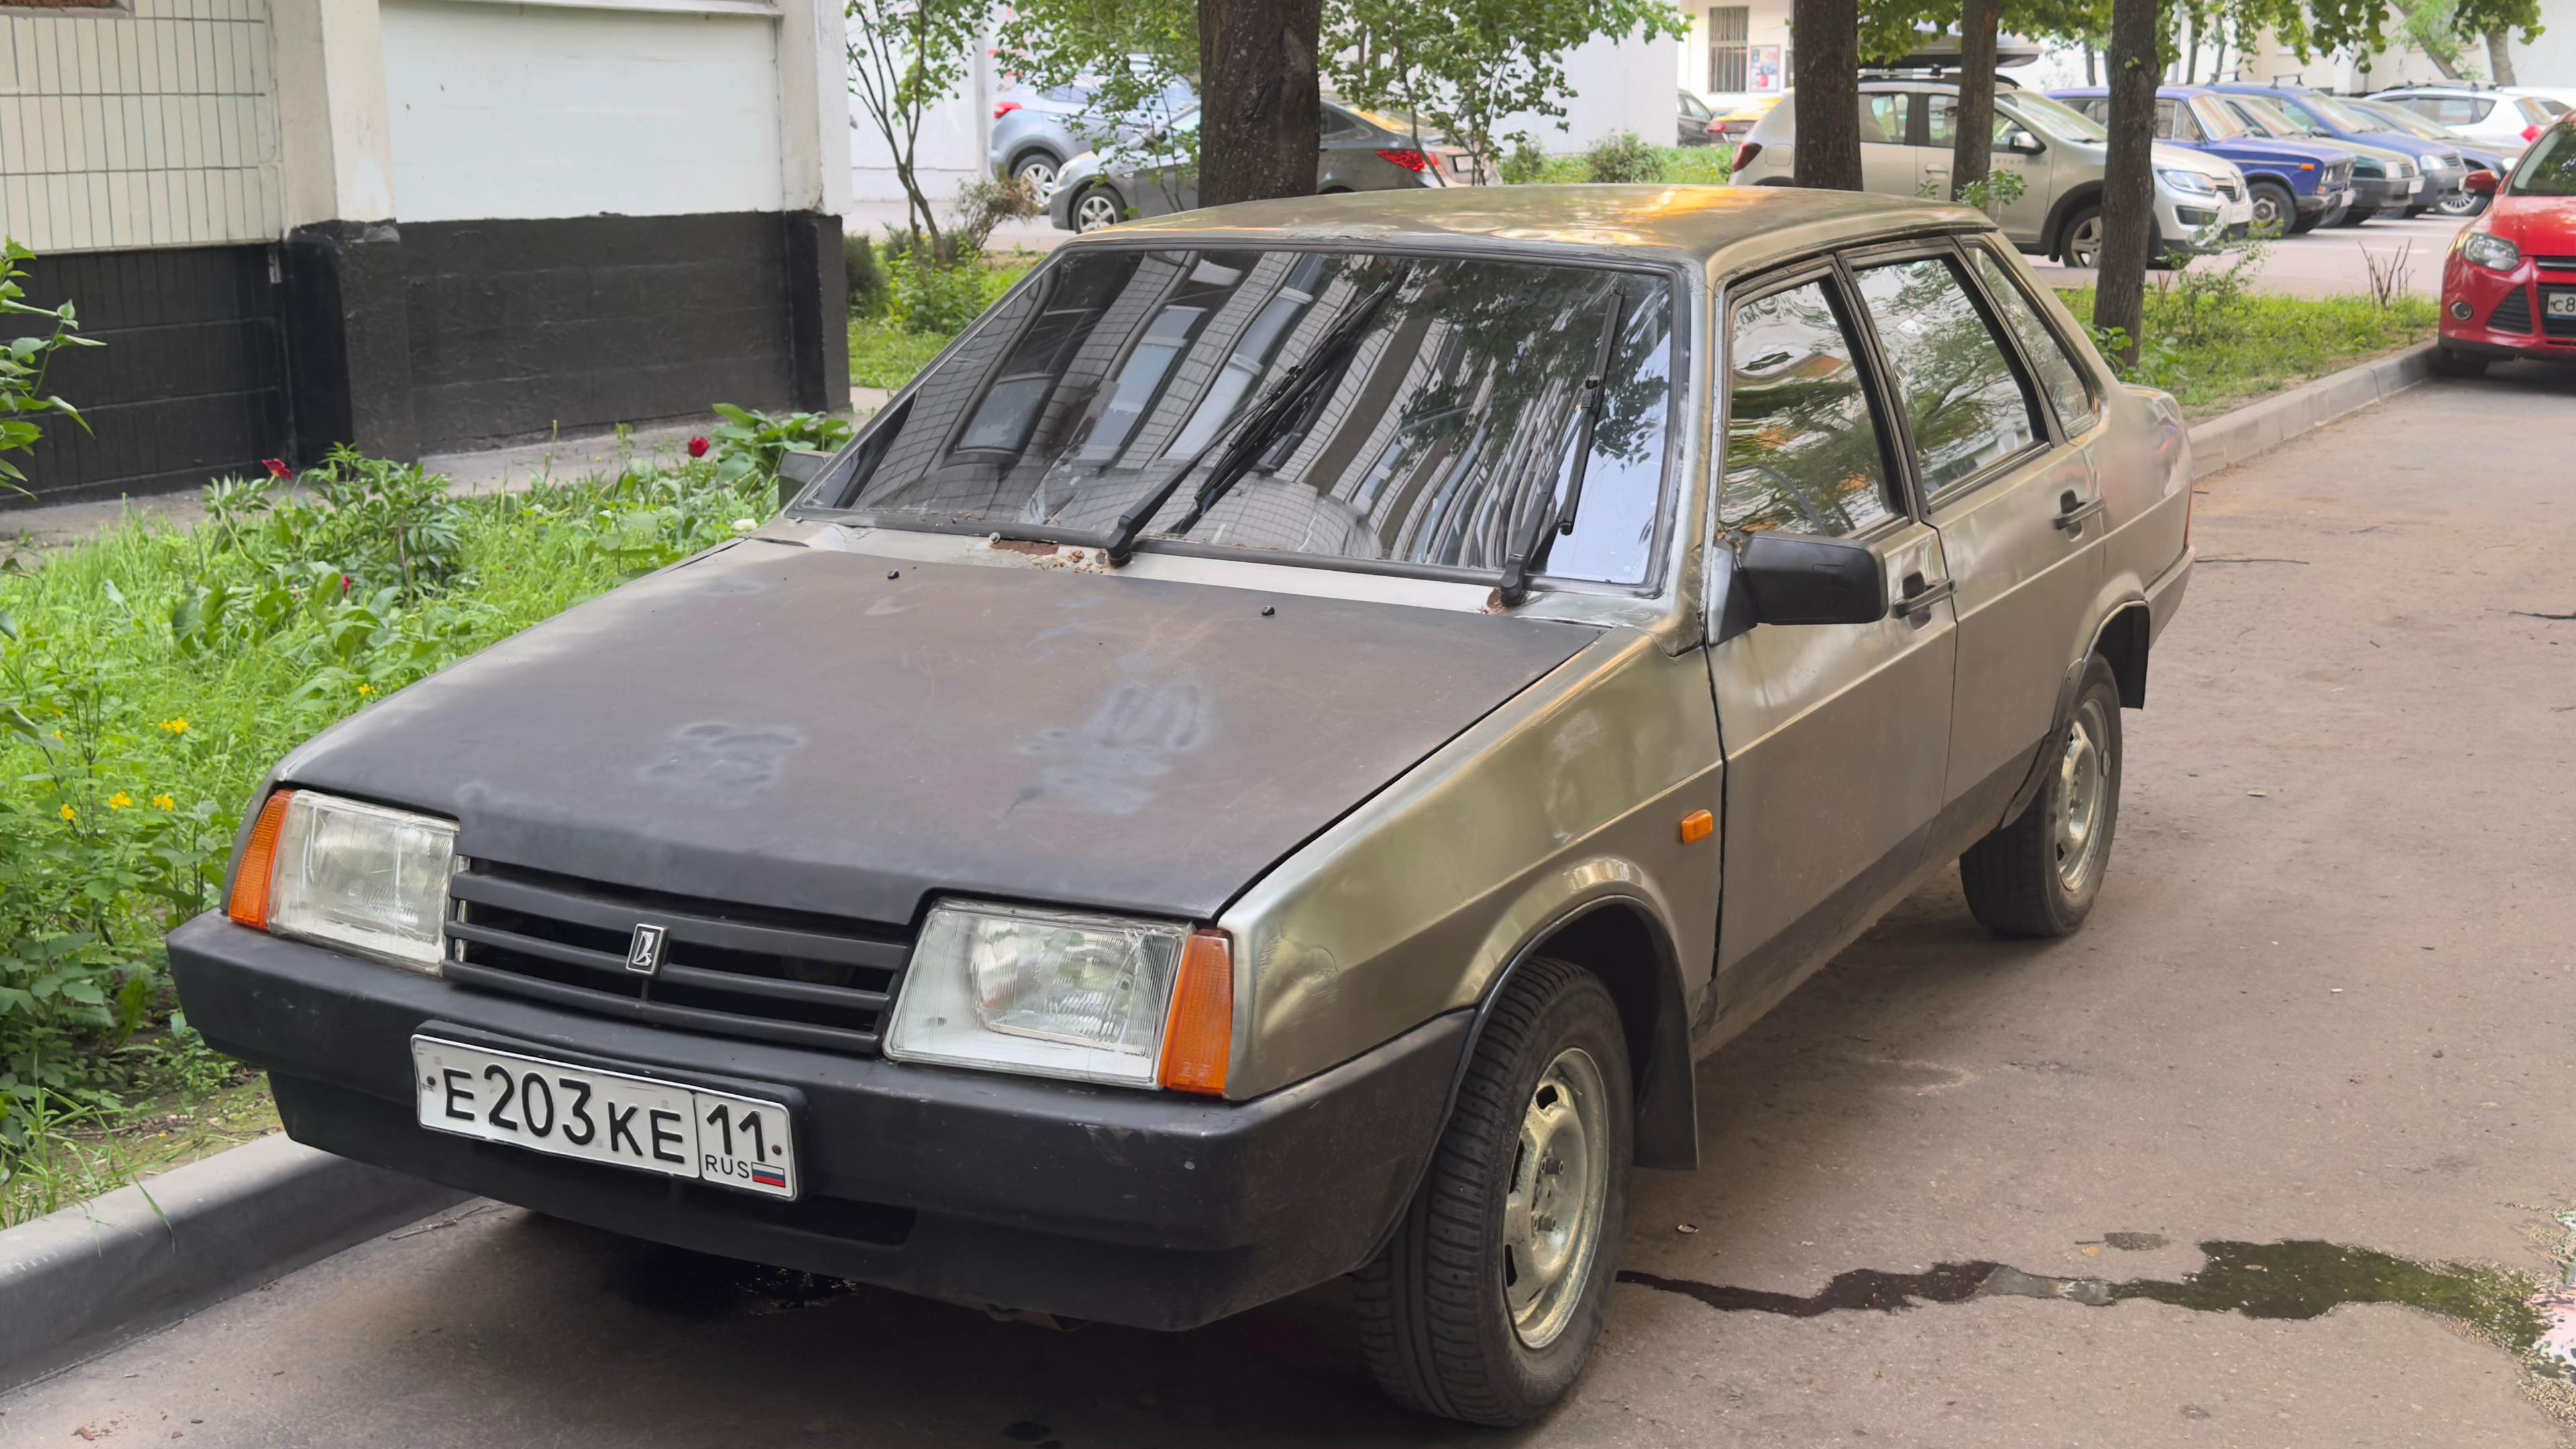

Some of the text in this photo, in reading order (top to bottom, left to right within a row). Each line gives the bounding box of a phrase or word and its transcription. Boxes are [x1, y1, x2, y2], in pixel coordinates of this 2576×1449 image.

[442, 1064, 765, 1165] Е203КЕ 11
[705, 1154, 750, 1179] RUS
